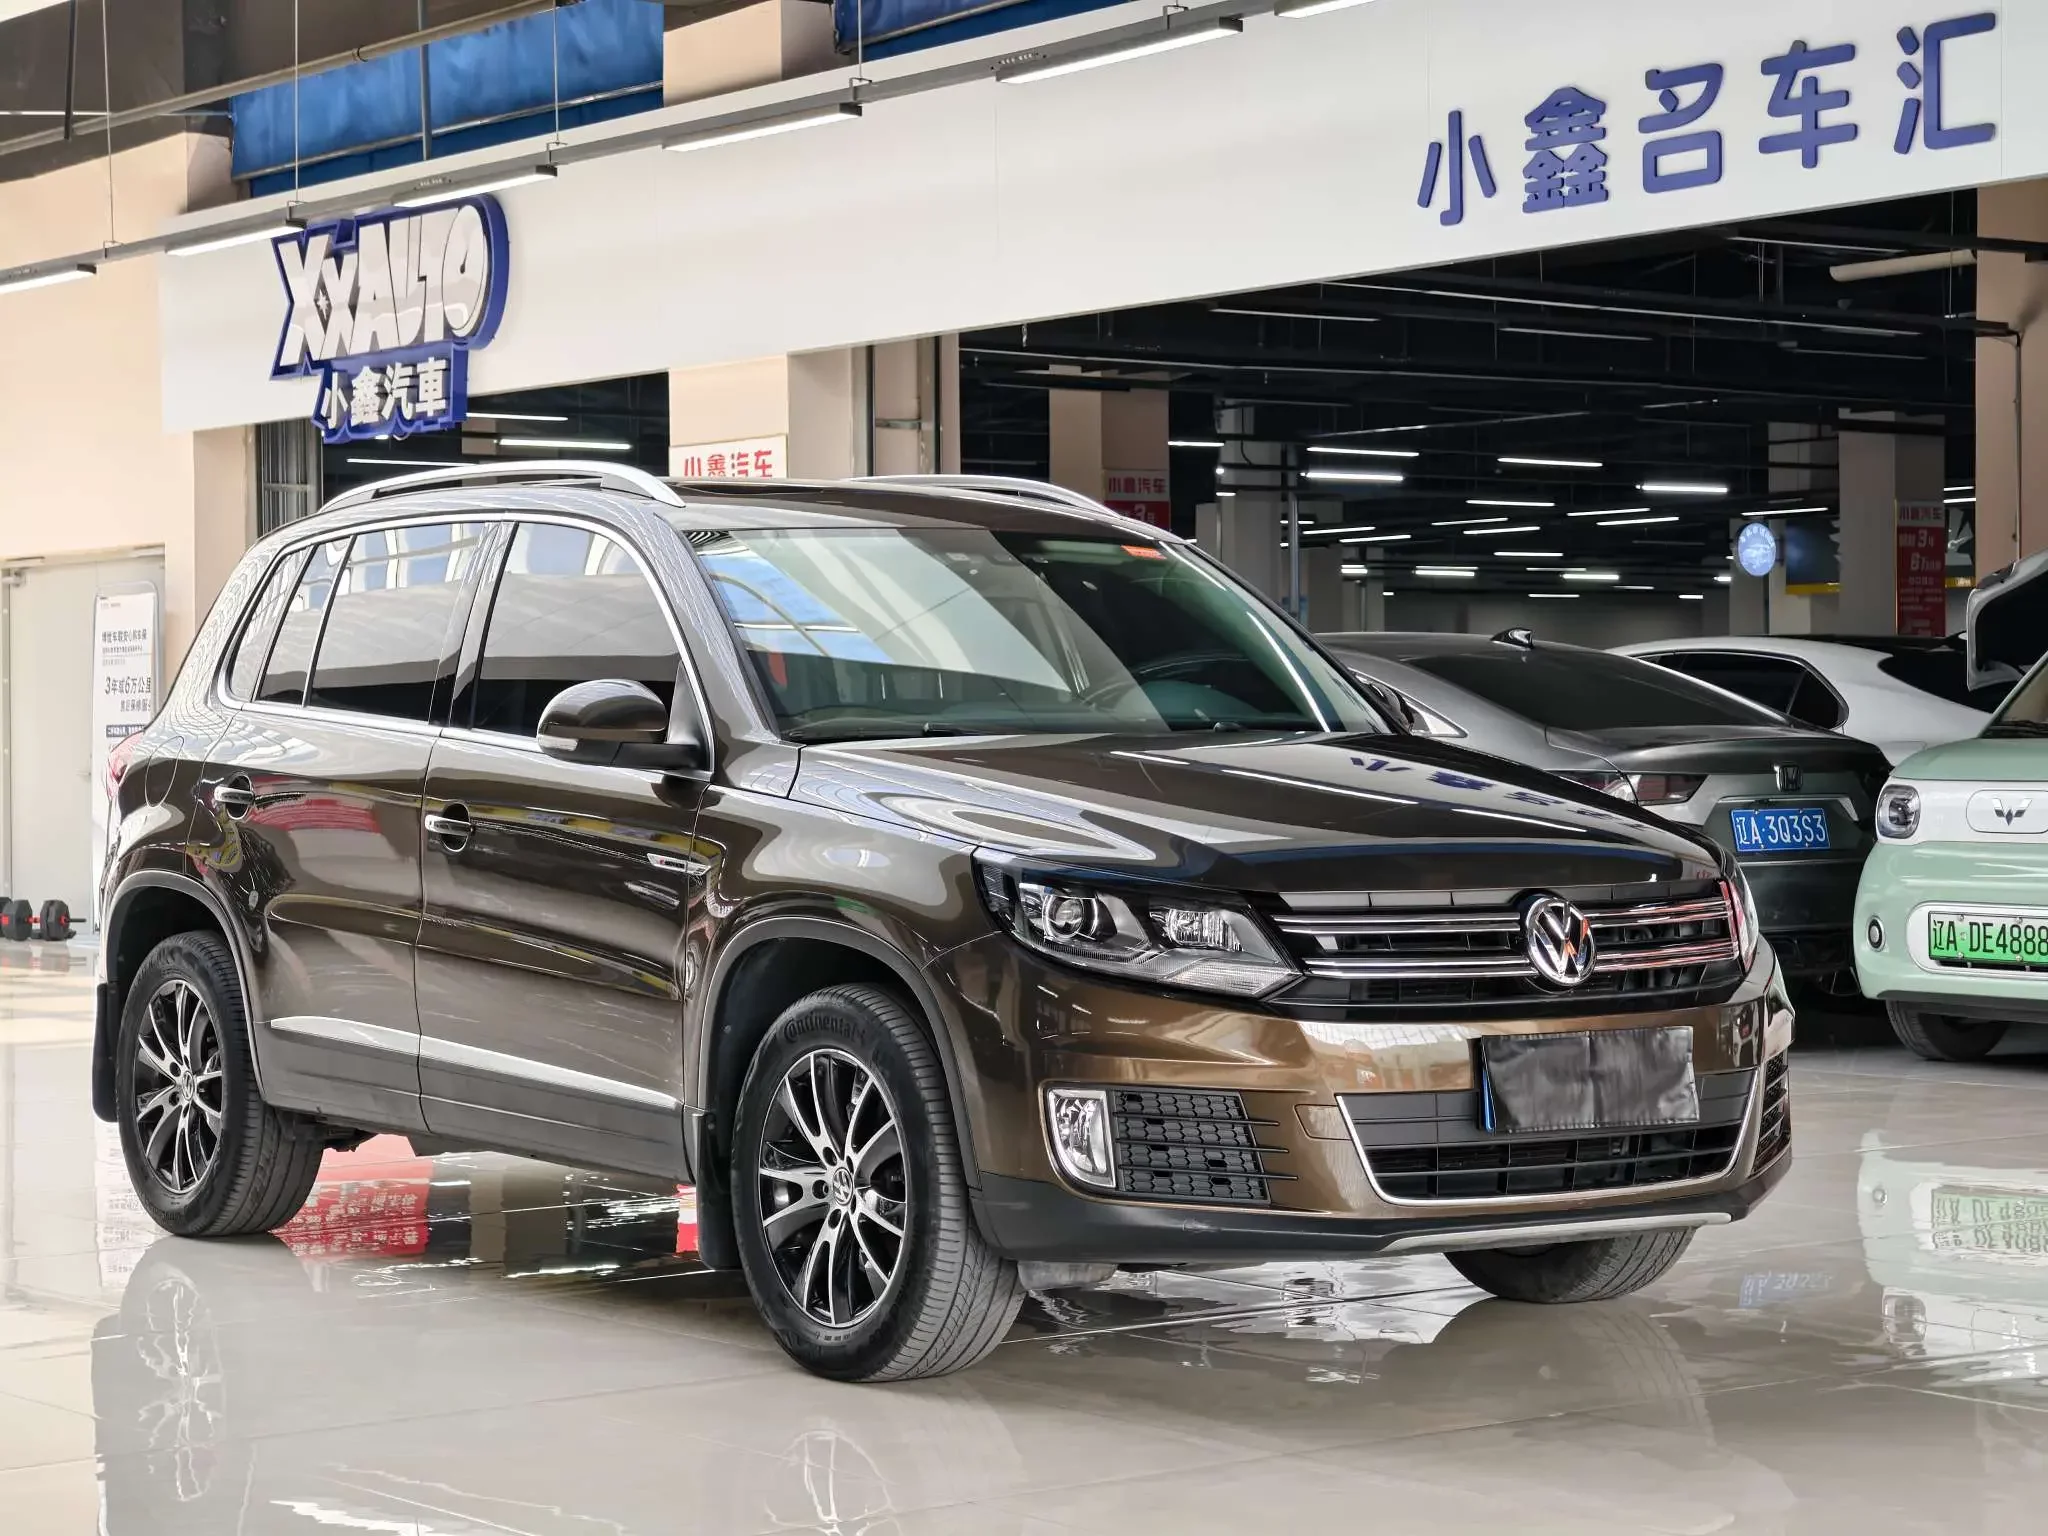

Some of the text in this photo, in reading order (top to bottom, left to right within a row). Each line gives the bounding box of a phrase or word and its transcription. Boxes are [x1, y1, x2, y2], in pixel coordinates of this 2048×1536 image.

[1417, 12, 1996, 226] 小鑫名车汇
[277, 204, 488, 367] XXAUTO
[320, 356, 447, 430] 小鑫汽車
[683, 449, 773, 478] 小鑫汽车
